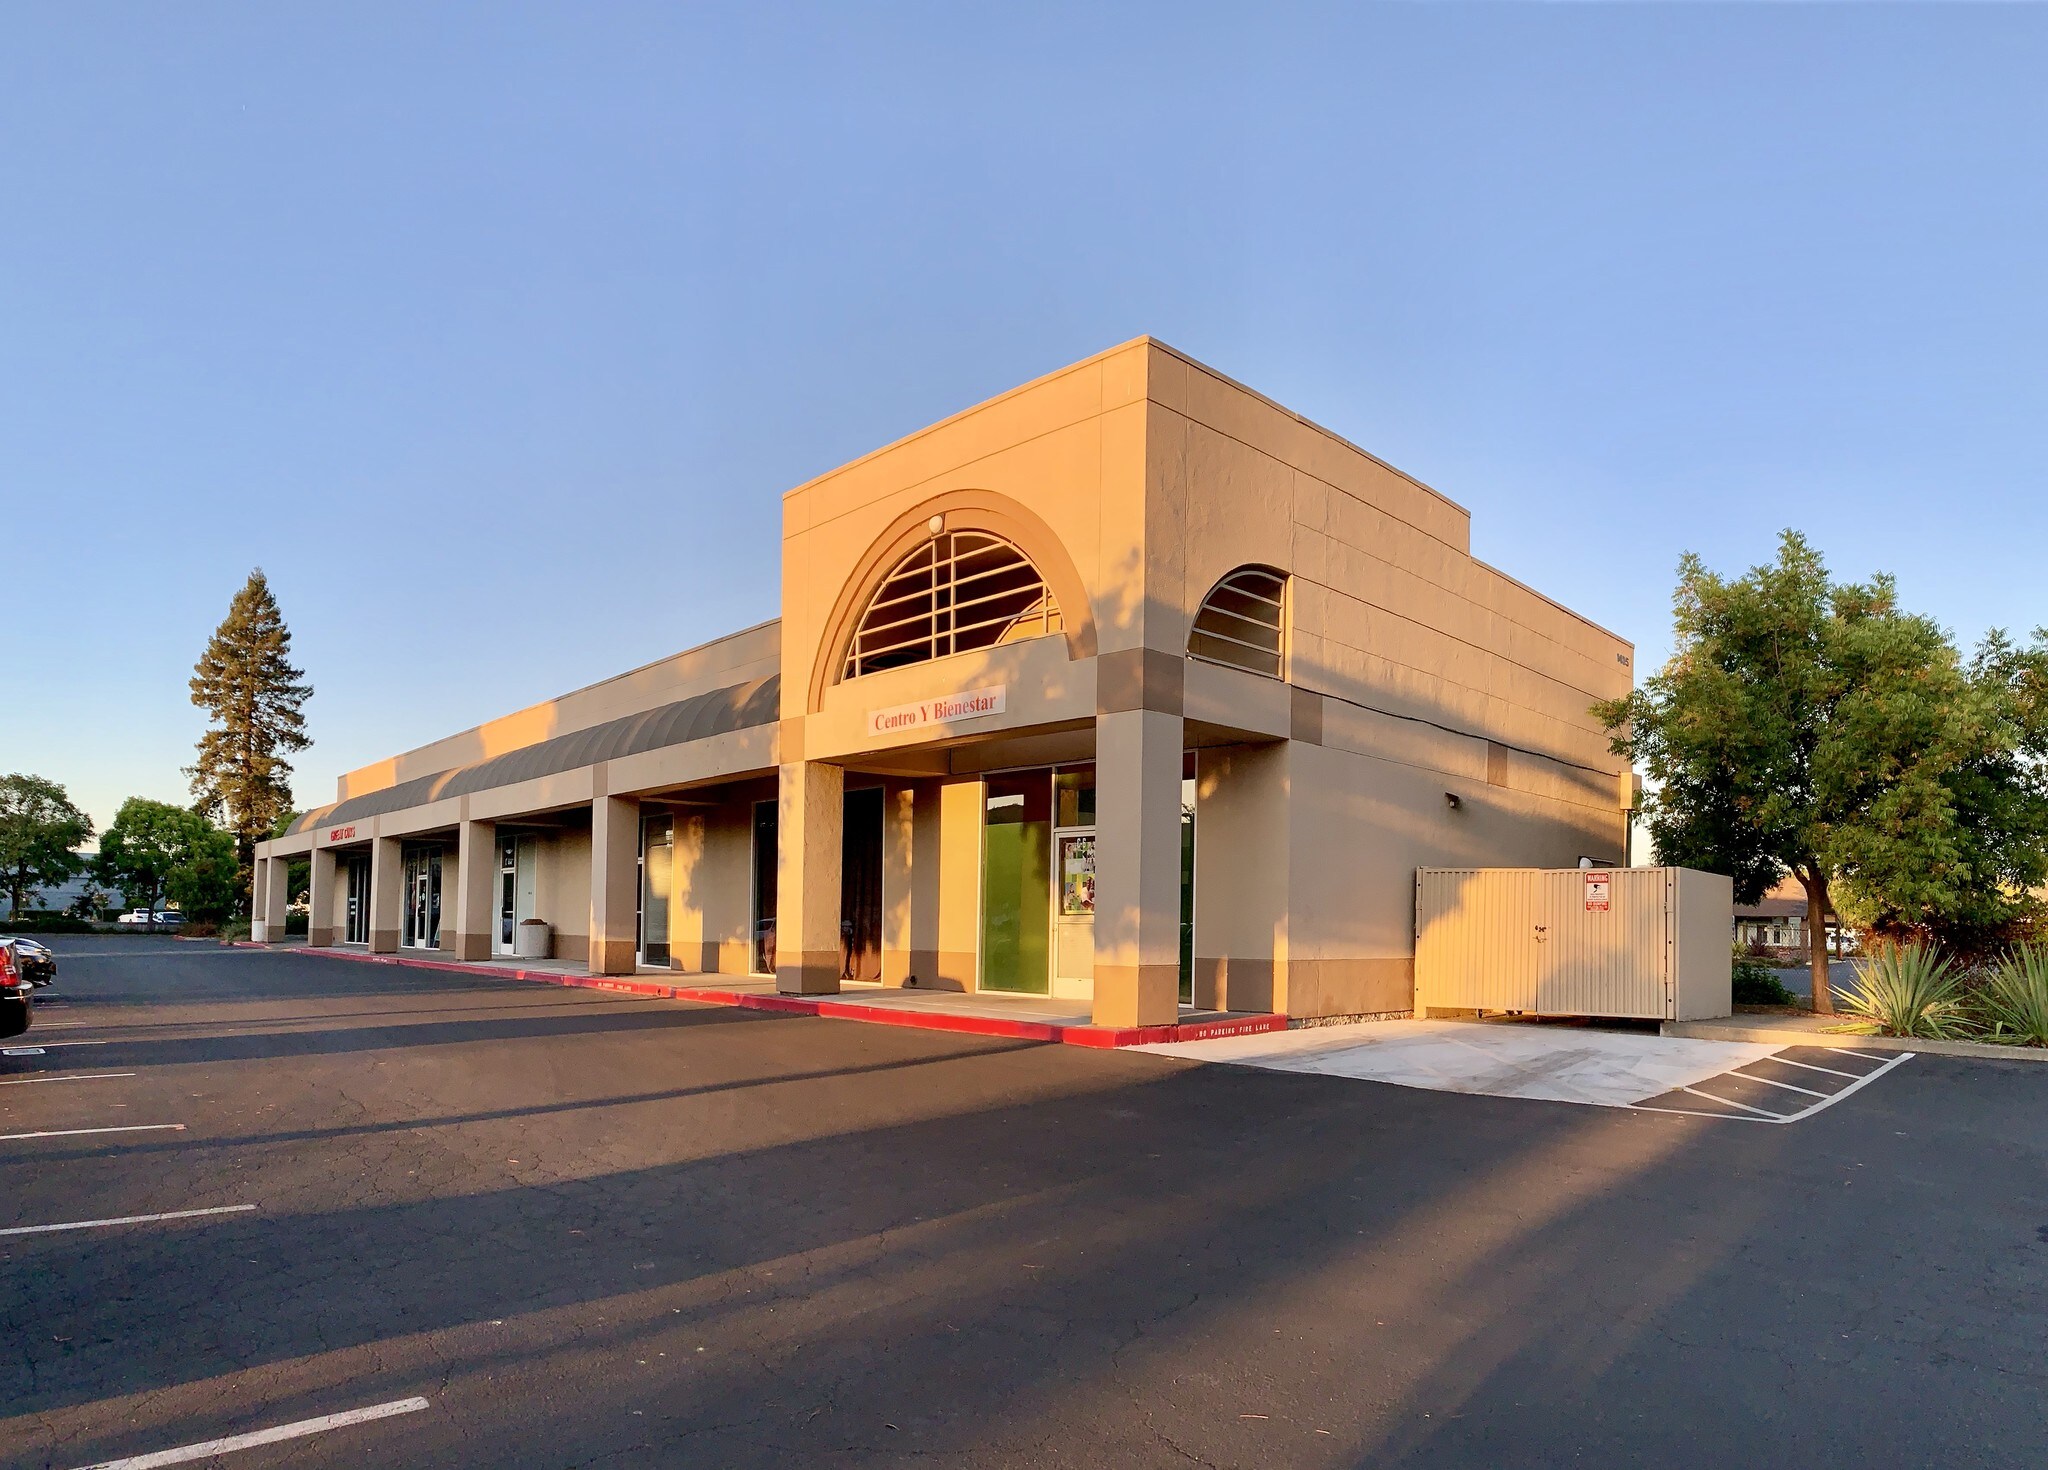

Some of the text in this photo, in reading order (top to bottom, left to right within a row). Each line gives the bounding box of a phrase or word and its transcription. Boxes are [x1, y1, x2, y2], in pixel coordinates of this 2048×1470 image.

[875, 695, 997, 731] Centro Y Bienestar
[1587, 874, 1608, 882] WARNING
[1210, 1027, 1235, 1036] PARKING
[1239, 1025, 1252, 1034] FIRE
[1255, 1023, 1270, 1032] LANE
